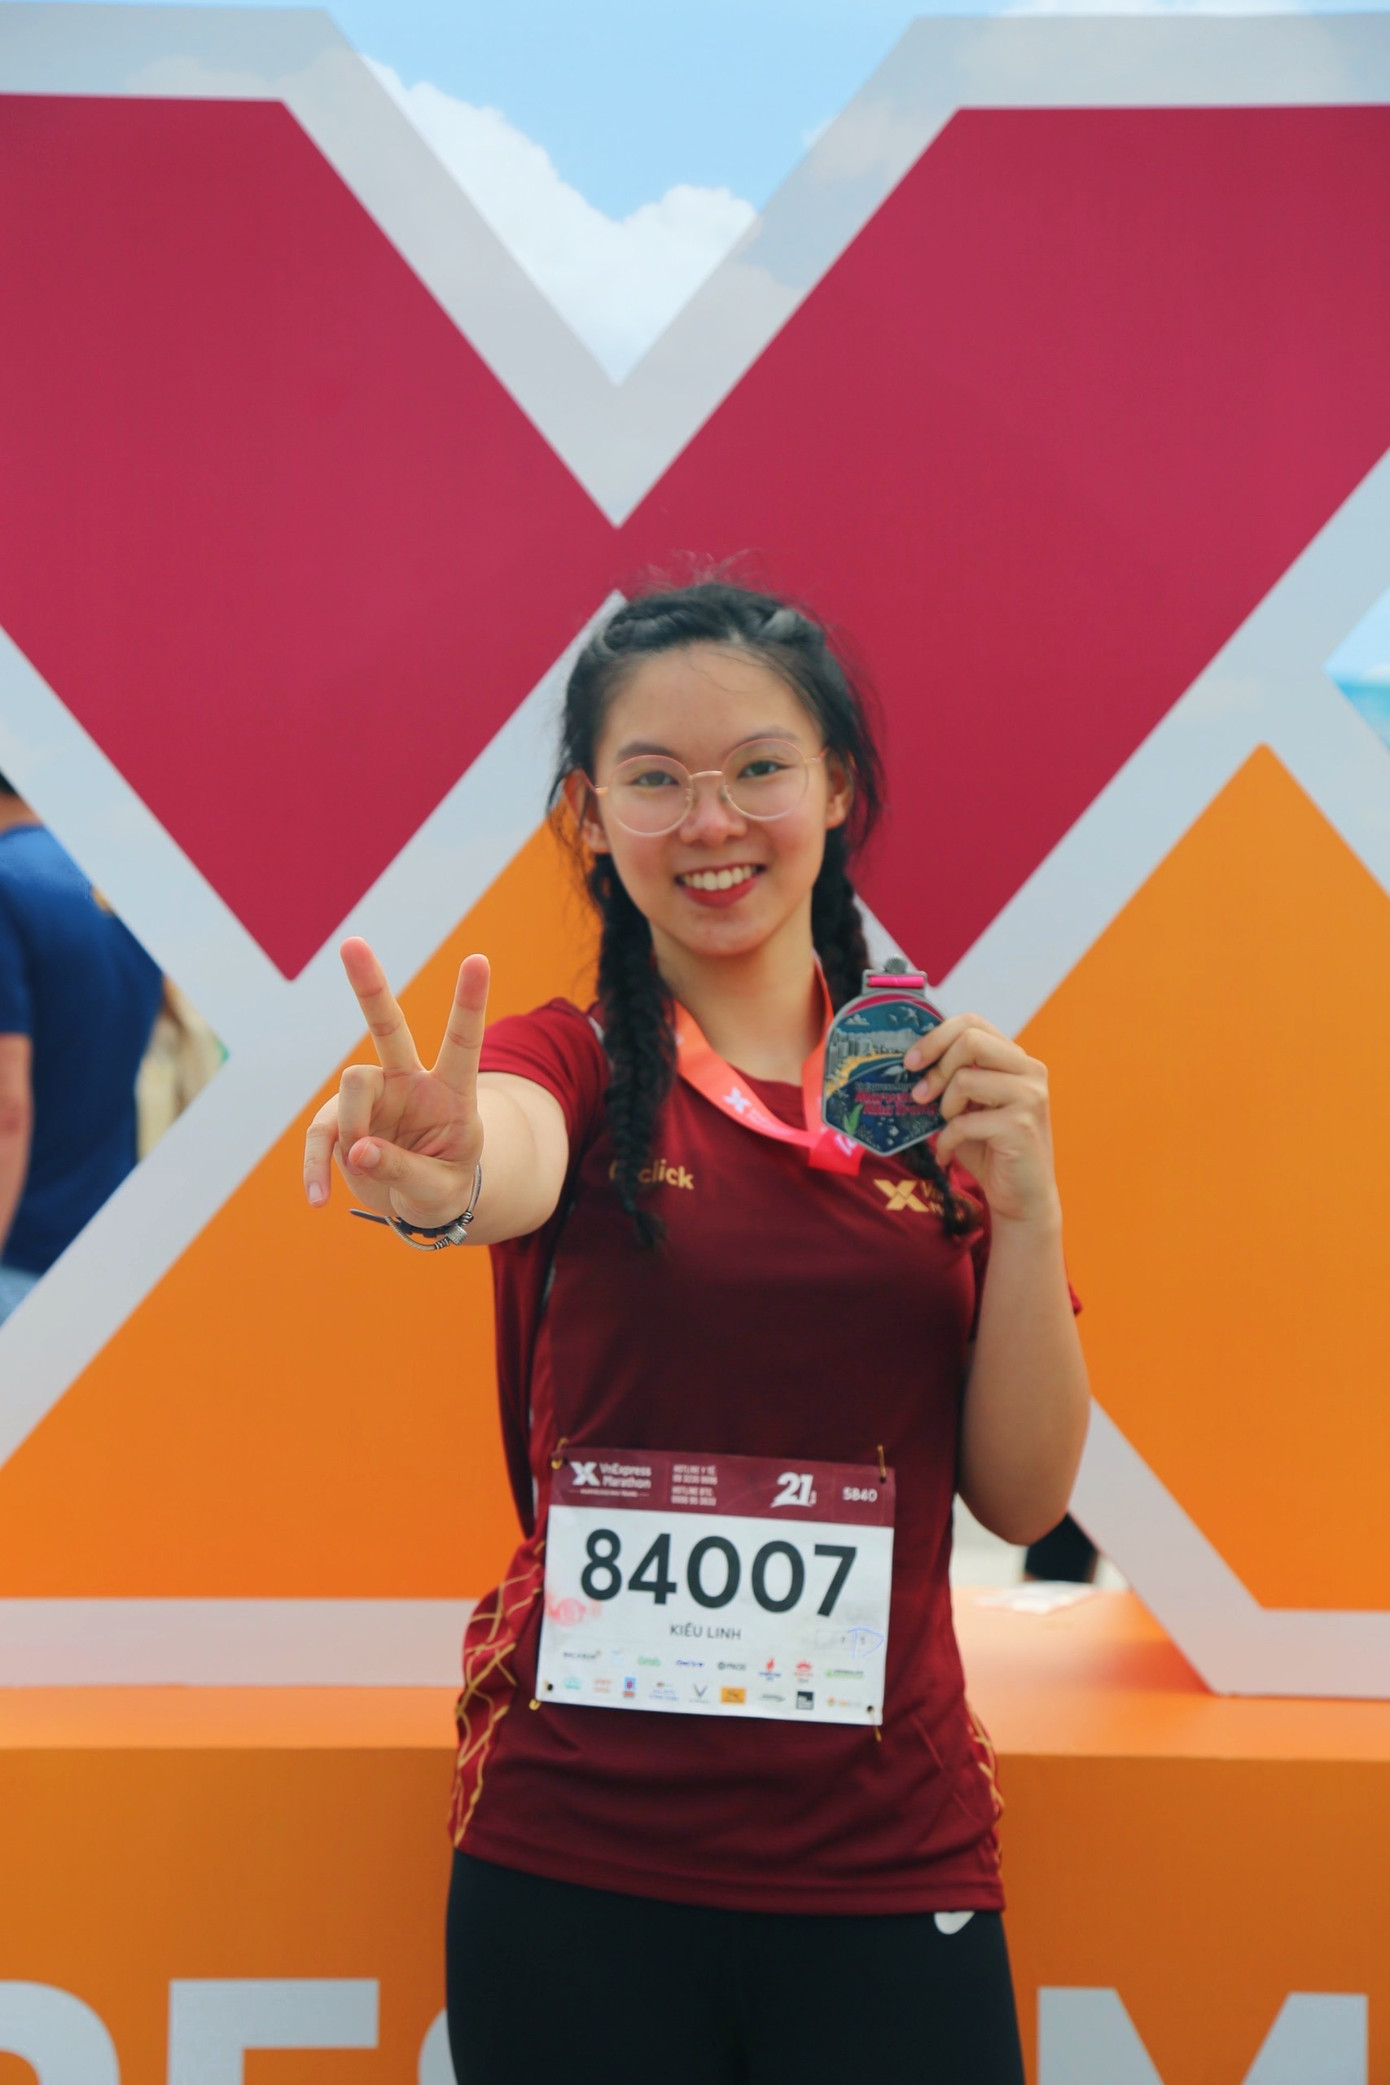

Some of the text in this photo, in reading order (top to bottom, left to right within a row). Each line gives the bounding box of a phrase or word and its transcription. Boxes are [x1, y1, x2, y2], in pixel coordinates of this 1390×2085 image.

[600, 1462, 652, 1477] VnExpress
[602, 1475, 652, 1489] Marathon
[581, 1528, 858, 1617] 84007
[707, 1626, 742, 1640] LINH
